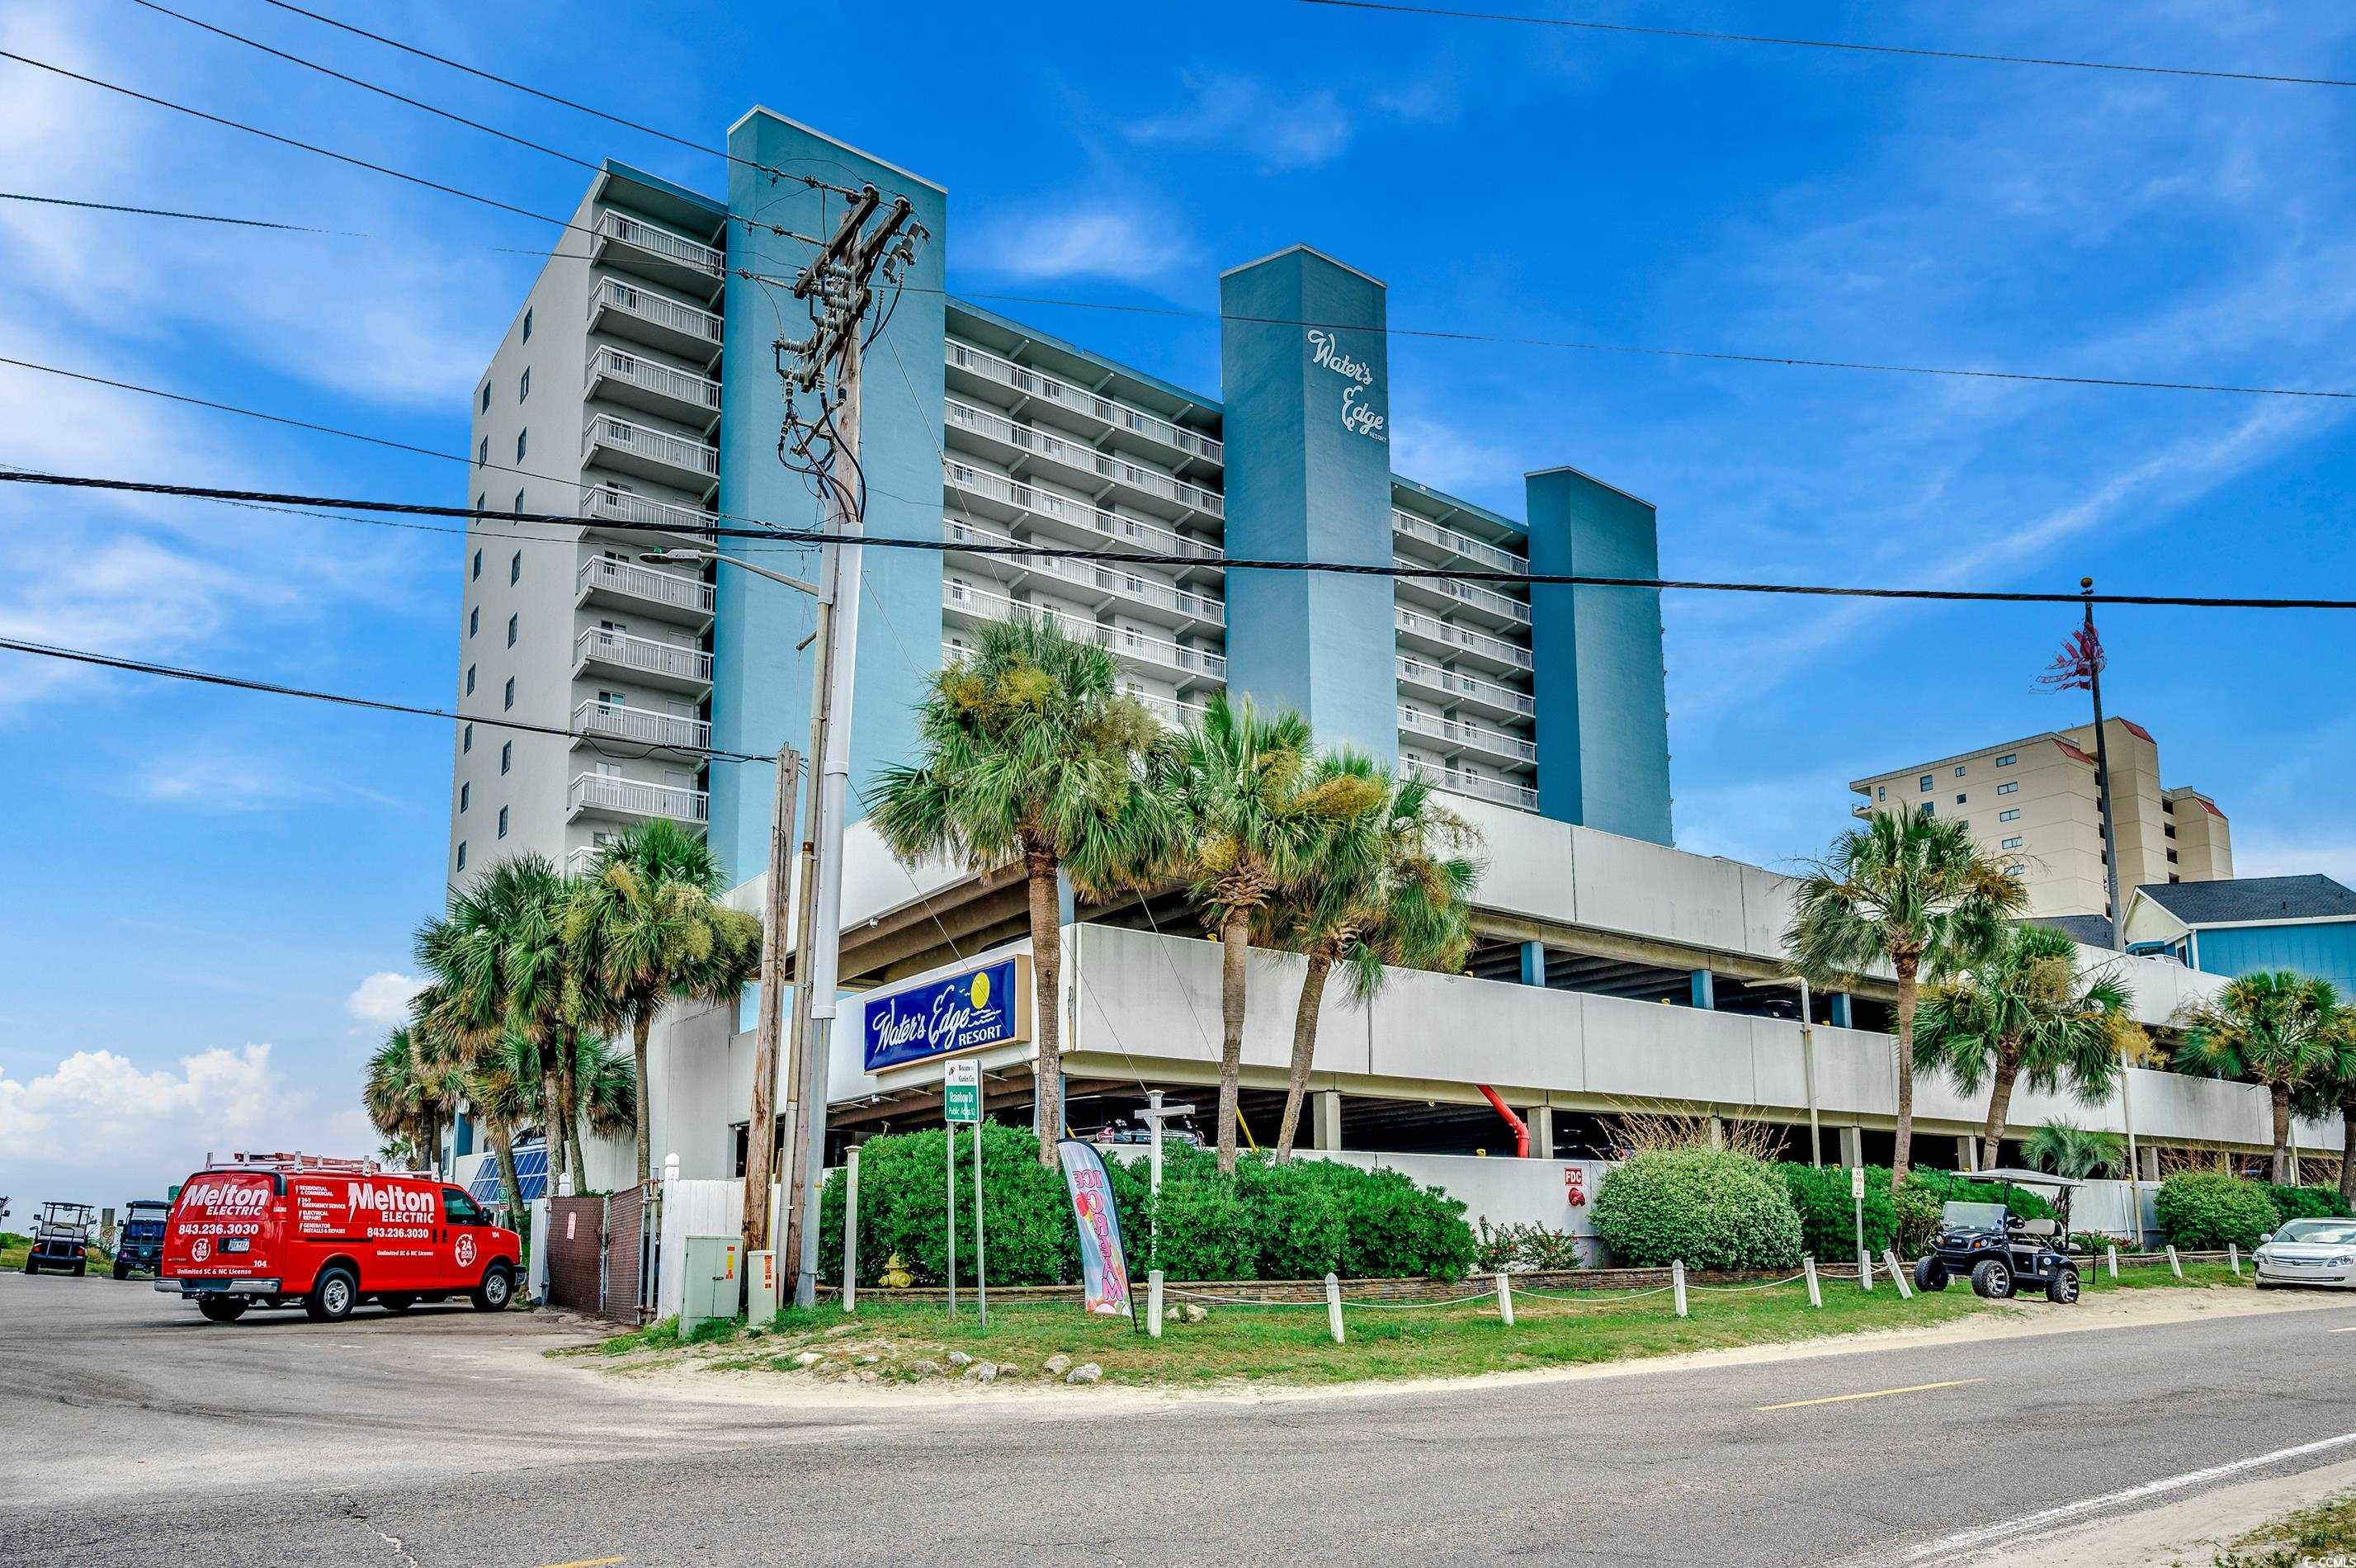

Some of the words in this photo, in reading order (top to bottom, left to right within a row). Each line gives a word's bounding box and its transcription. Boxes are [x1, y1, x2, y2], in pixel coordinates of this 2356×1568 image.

[1307, 329, 1373, 385] Water's
[1341, 385, 1384, 435] Edge
[872, 998, 926, 1054] Water's
[928, 985, 970, 1050] Edge
[958, 1024, 1002, 1046] RESORT
[950, 1091, 968, 1103] Rainbow
[948, 1107, 960, 1115] Public
[1565, 1170, 1582, 1183] FDC
[178, 1183, 269, 1217] Melton
[347, 1182, 435, 1223] Melton
[205, 1206, 263, 1216] ELECTRIC
[381, 1211, 434, 1223] ELECTRIC
[178, 1223, 259, 1235] 843.236.3030
[367, 1226, 429, 1239] 843.236.3030
[461, 1240, 472, 1250] 24
[253, 1259, 267, 1268] 104
